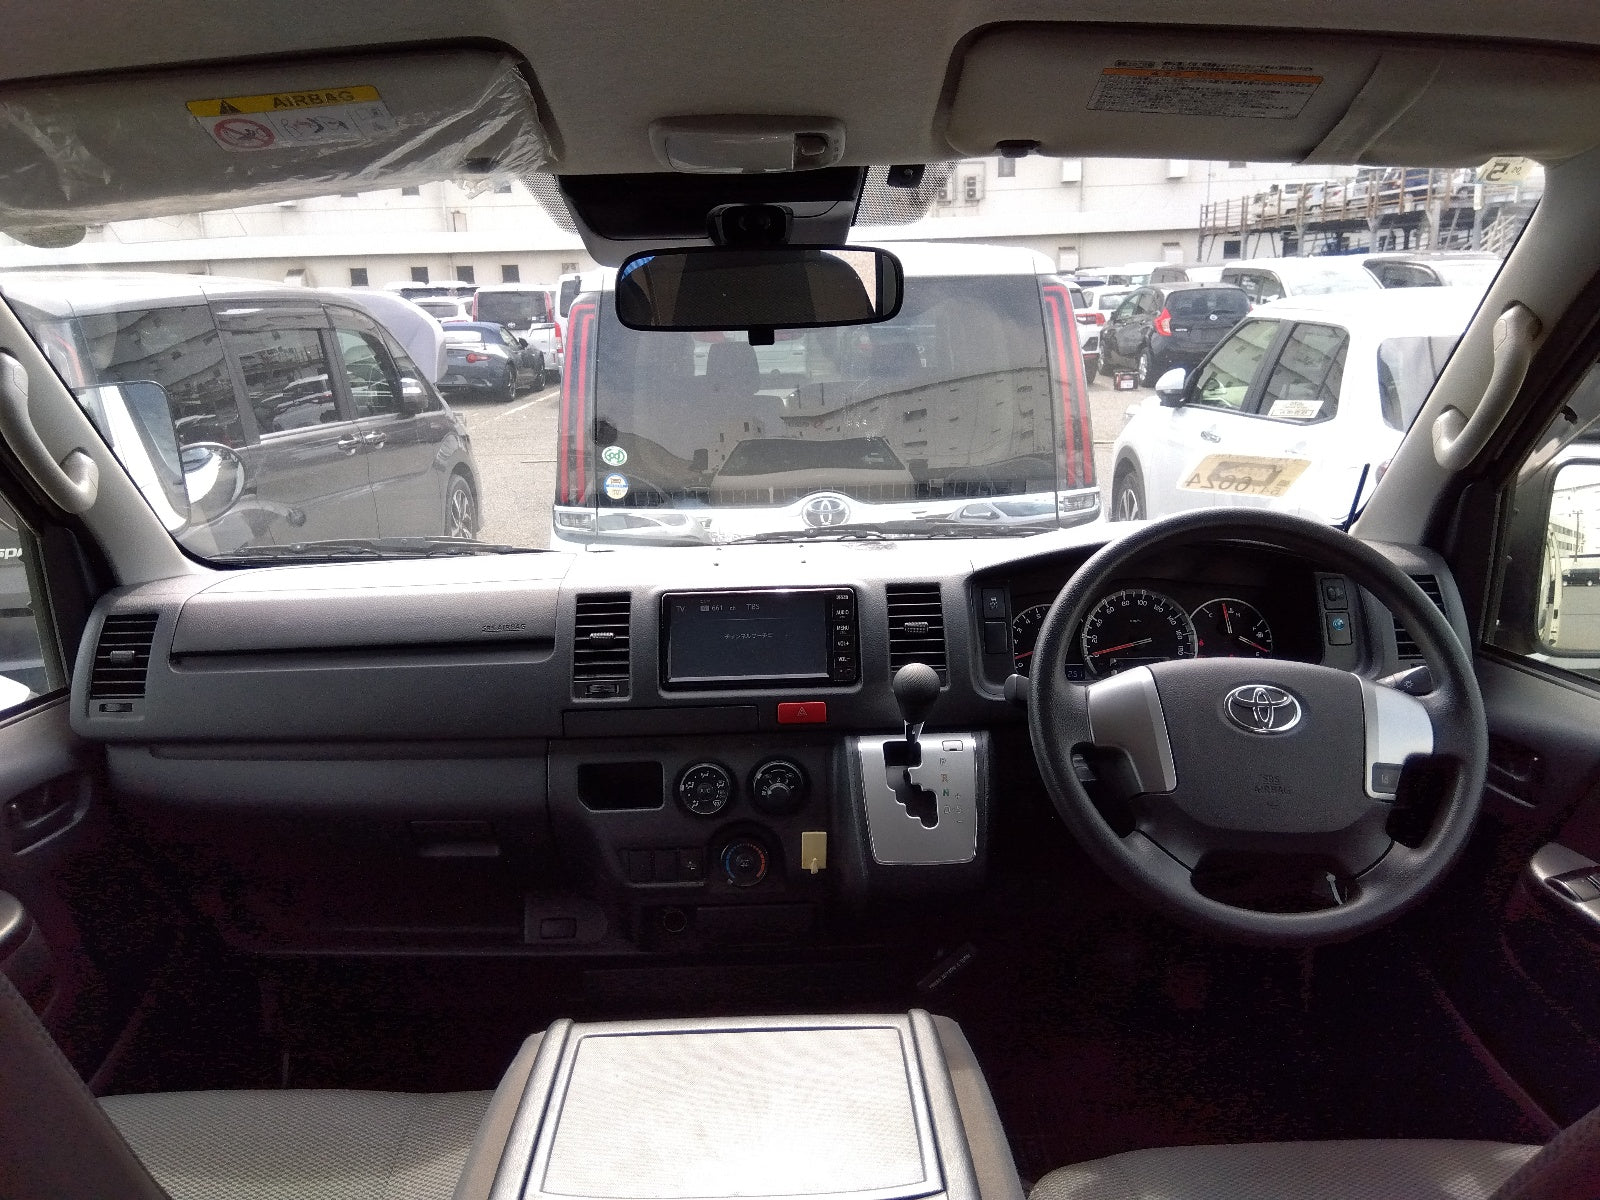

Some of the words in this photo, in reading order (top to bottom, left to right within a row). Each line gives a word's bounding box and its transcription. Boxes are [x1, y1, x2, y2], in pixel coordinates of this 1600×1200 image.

[272, 90, 355, 110] AIRBAG
[1121, 599, 1130, 607] 80
[1137, 599, 1148, 607] 100
[676, 605, 686, 613] TV
[1106, 606, 1115, 615] 60
[1167, 616, 1177, 626] 140
[497, 623, 526, 632] AIRBAG
[1091, 634, 1098, 644] 20
[1175, 629, 1183, 640] 160
[942, 789, 950, 797] N
[1254, 785, 1291, 795] AIRBAG
